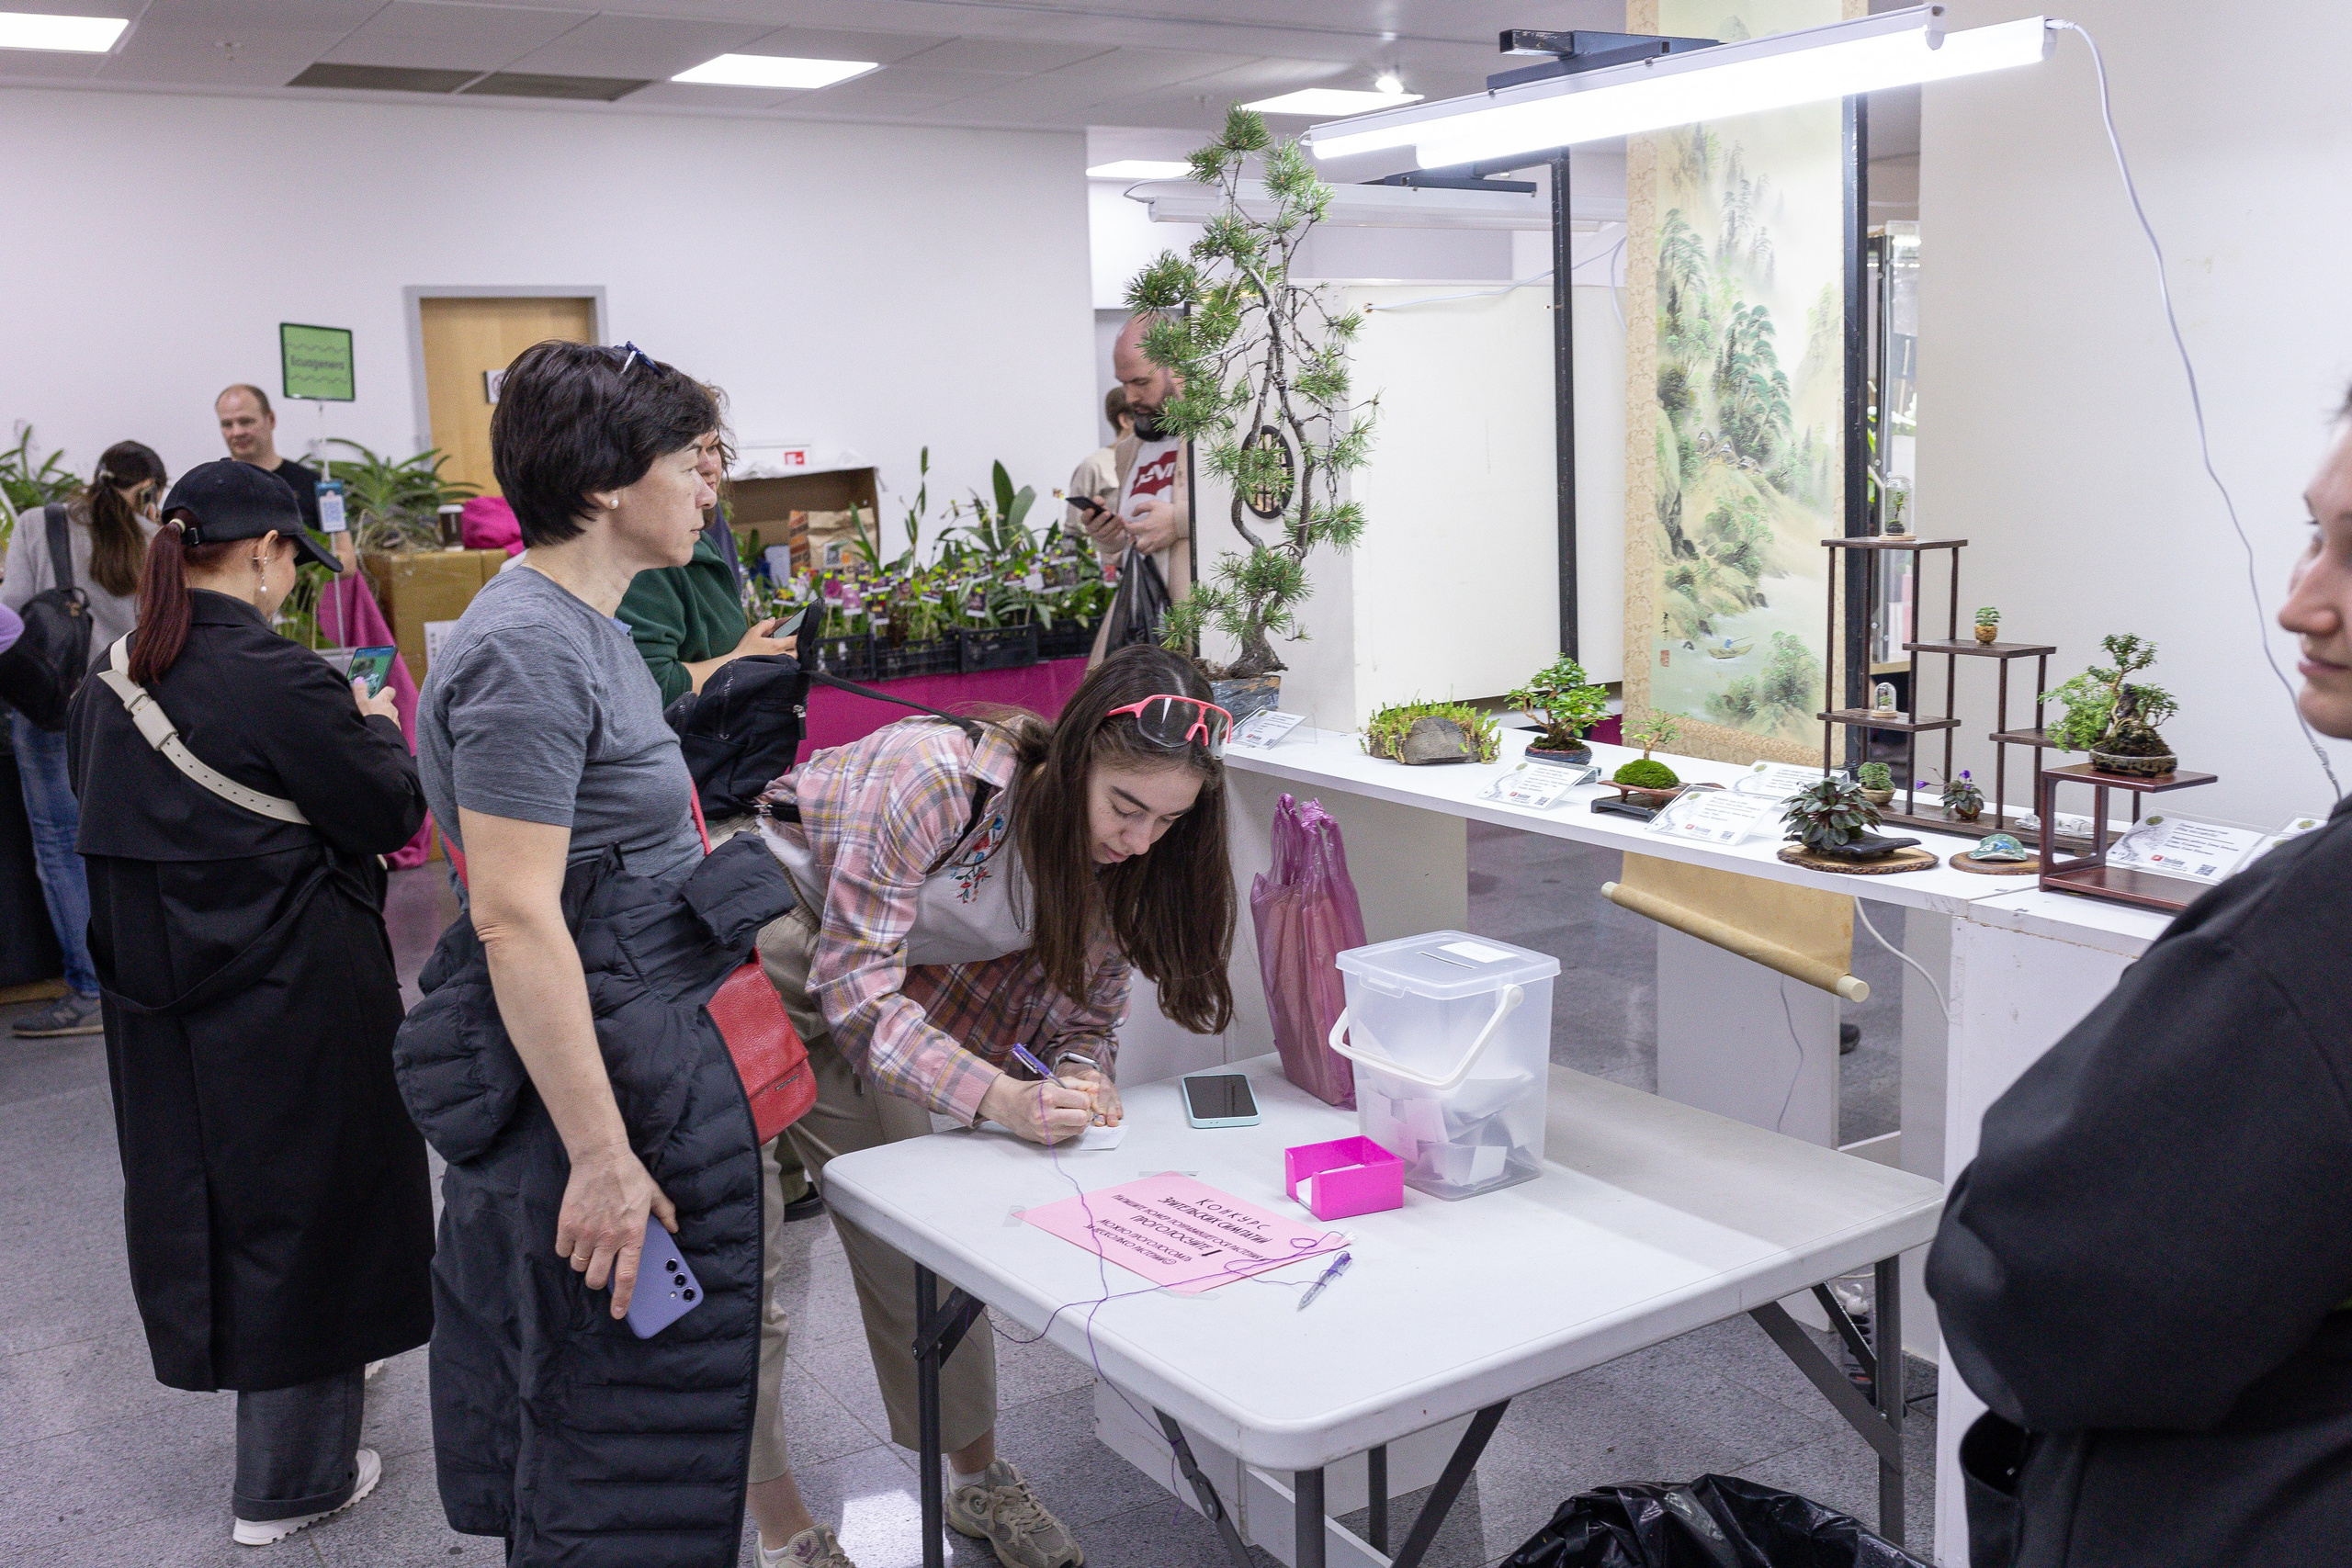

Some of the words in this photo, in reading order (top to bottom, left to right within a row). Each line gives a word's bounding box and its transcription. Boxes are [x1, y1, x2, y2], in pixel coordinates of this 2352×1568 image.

[1143, 1209, 1170, 1220] НОМЕР
[1158, 1197, 1223, 1224] ЗРИТЕЛЬСКИХ
[1217, 1222, 1272, 1244] СИМПАТИЙ
[1195, 1199, 1271, 1230] КОНКУРС
[1097, 1219, 1132, 1234] МОЖНО
[1128, 1234, 1193, 1261] ПРОГОЛОСОВАТЬ
[1130, 1215, 1213, 1250] ПРОГОЛОСУЙТЕ
